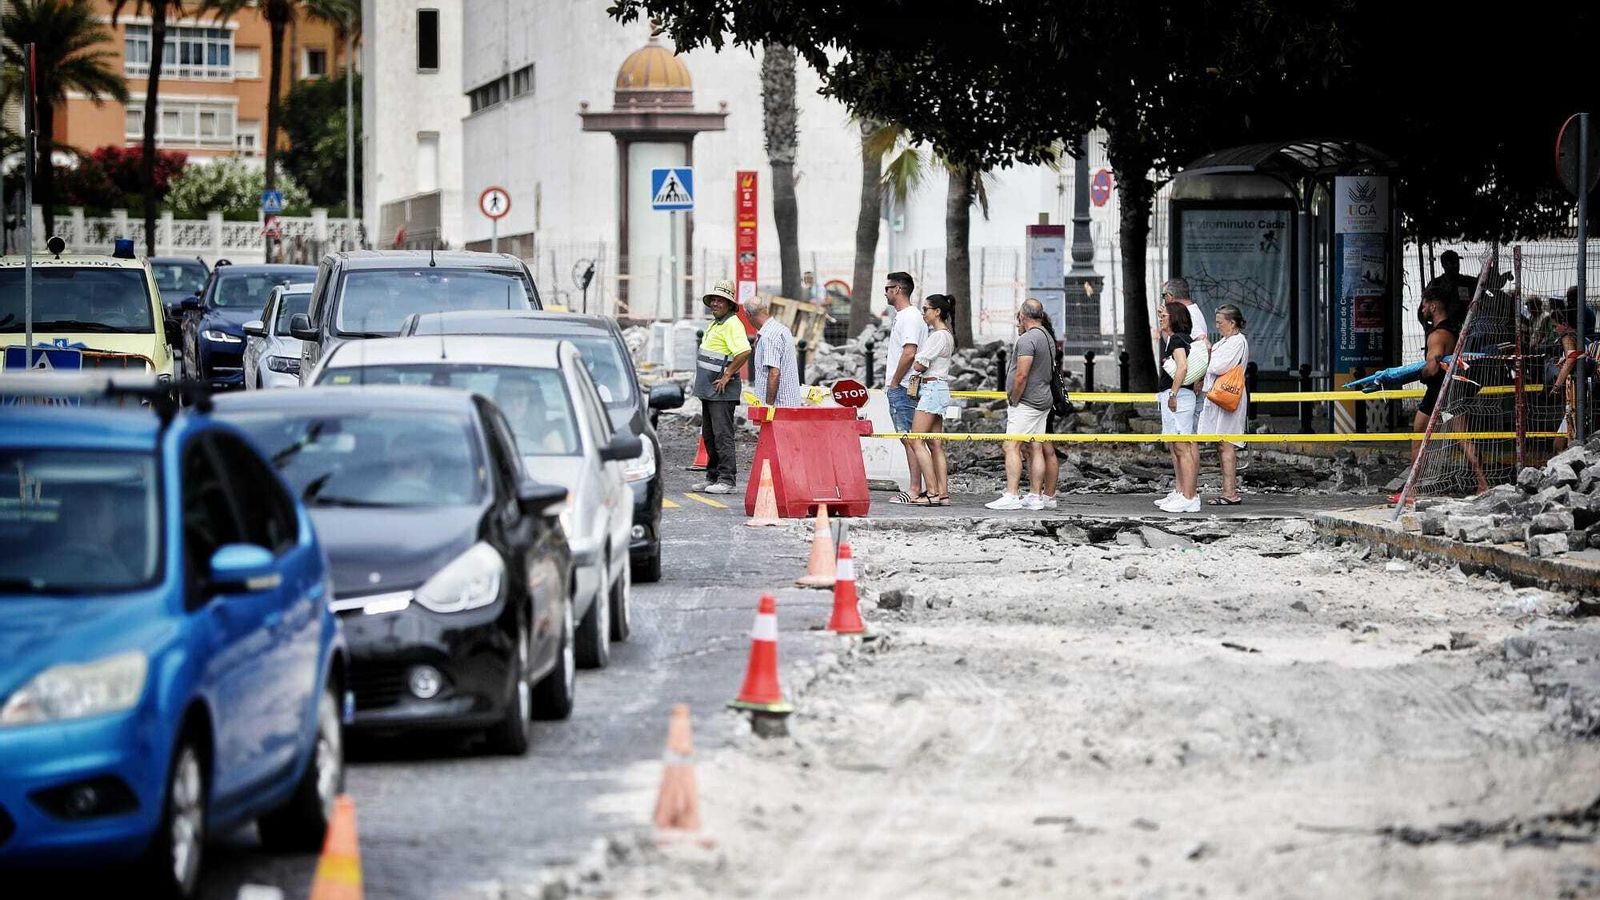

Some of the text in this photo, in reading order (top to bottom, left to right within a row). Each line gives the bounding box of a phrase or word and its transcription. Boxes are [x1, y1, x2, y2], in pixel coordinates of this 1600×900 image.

[1347, 204, 1377, 216] UCA
[1185, 219, 1256, 229] mtrominuto
[1340, 306, 1347, 317] de
[834, 390, 866, 400] STOP
